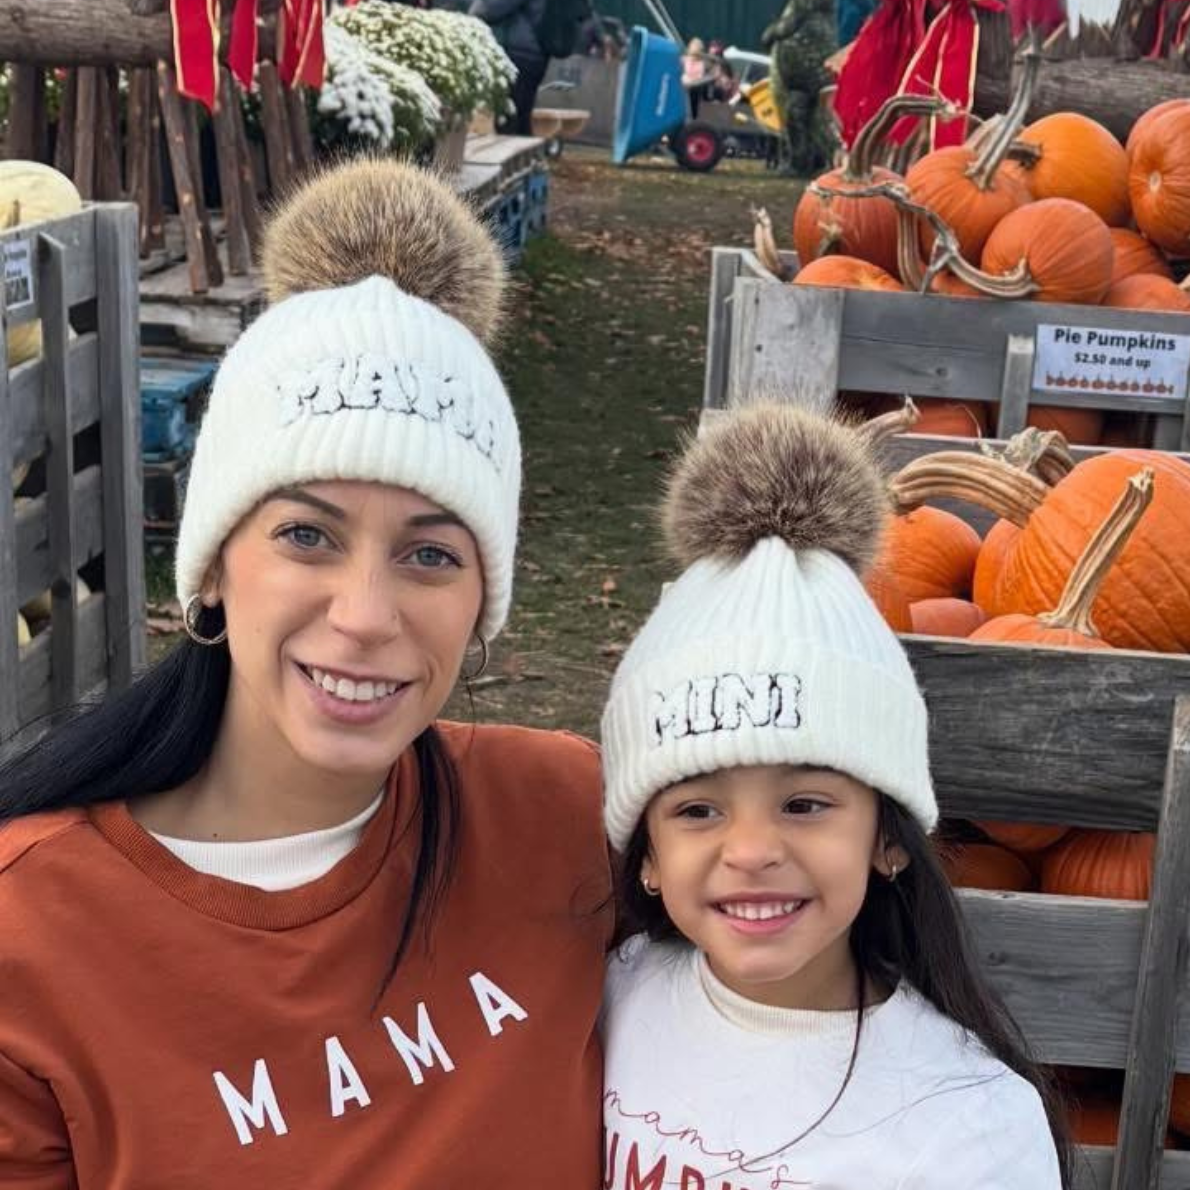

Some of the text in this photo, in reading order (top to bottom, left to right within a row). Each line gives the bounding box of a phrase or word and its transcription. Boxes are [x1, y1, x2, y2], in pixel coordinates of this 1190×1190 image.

[1054, 328, 1176, 351] Pie Pumpkins
[1074, 352, 1151, 370] $2.50 and up
[650, 672, 802, 747] MINI
[212, 971, 529, 1145] MAMA
